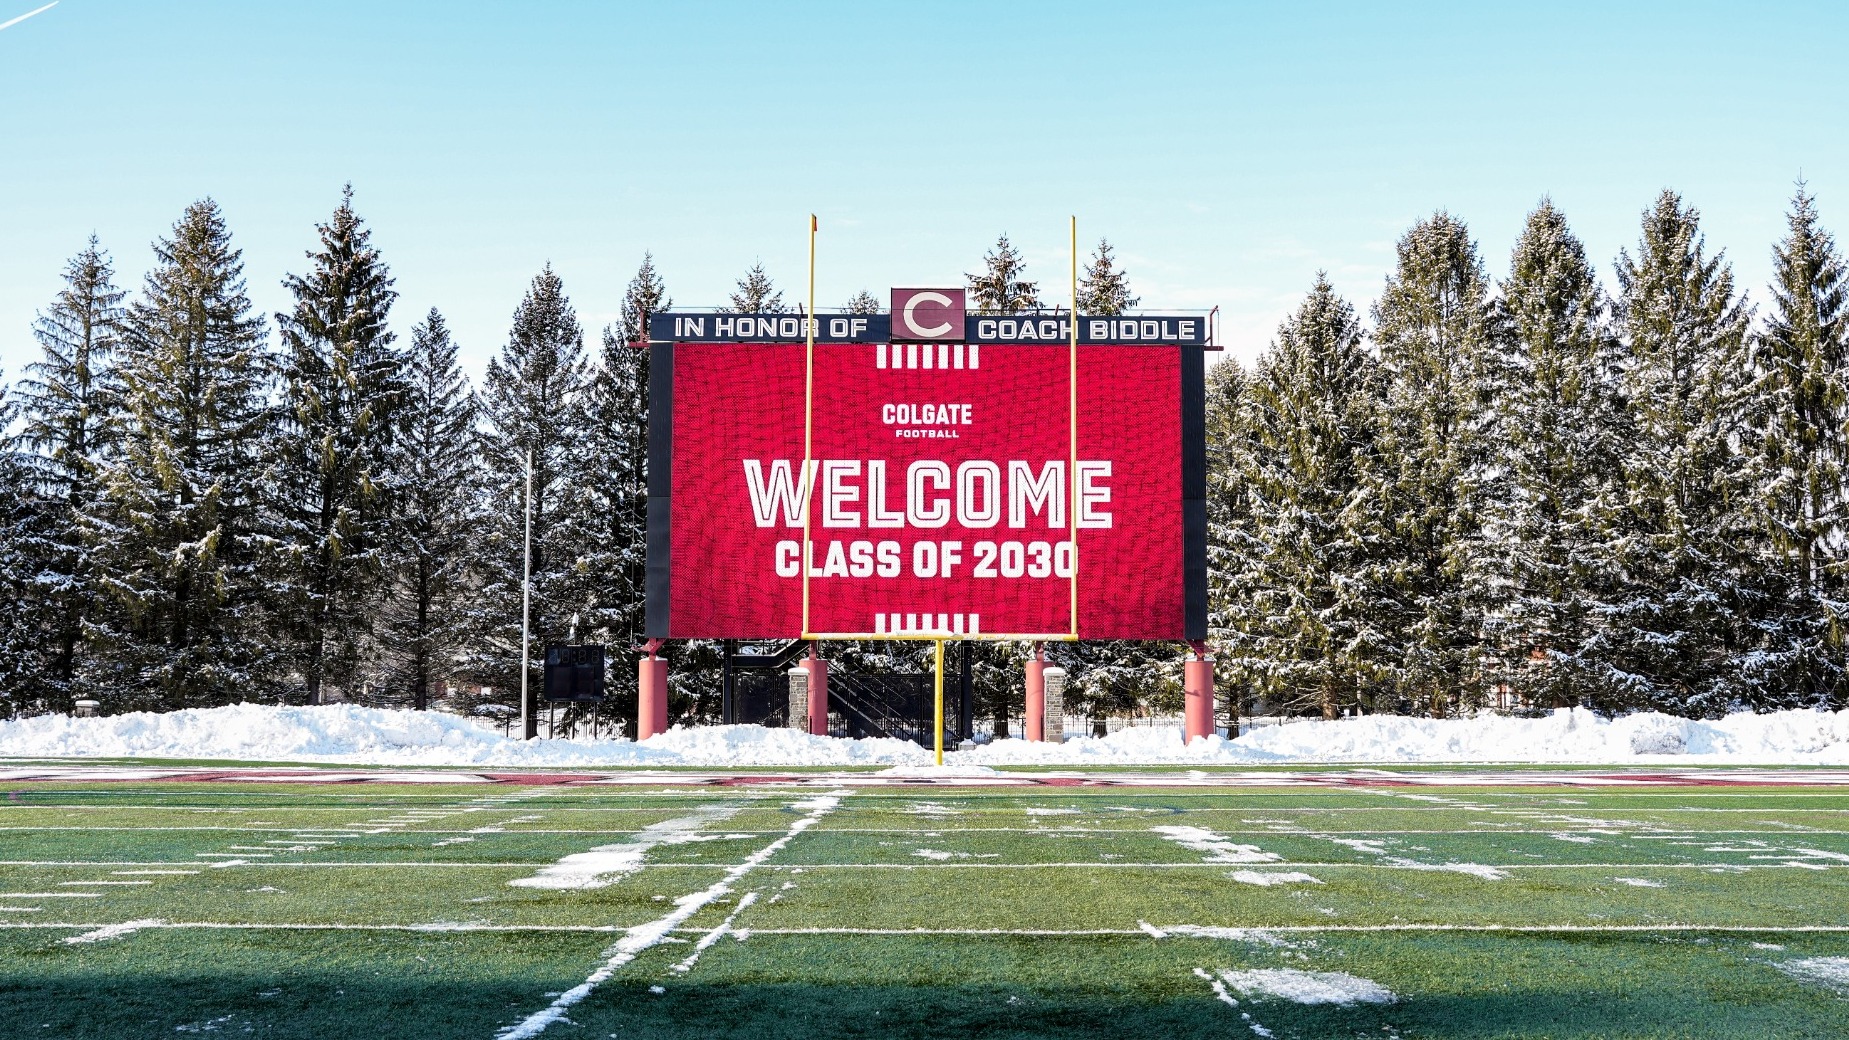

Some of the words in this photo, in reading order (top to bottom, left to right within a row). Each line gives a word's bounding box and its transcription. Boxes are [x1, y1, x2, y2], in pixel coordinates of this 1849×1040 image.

[903, 291, 953, 338] C
[674, 317, 705, 337] IN
[715, 317, 820, 338] HONOR
[829, 318, 868, 338] OF
[977, 319, 1079, 340] COACH
[1089, 320, 1195, 340] BIDDLE
[882, 403, 973, 425] COLGATE
[895, 429, 960, 438] FOOTBALL
[742, 459, 1113, 529] WELCOME
[775, 540, 901, 578] CLASS
[913, 540, 963, 578] OF
[973, 540, 1079, 579] 2030
